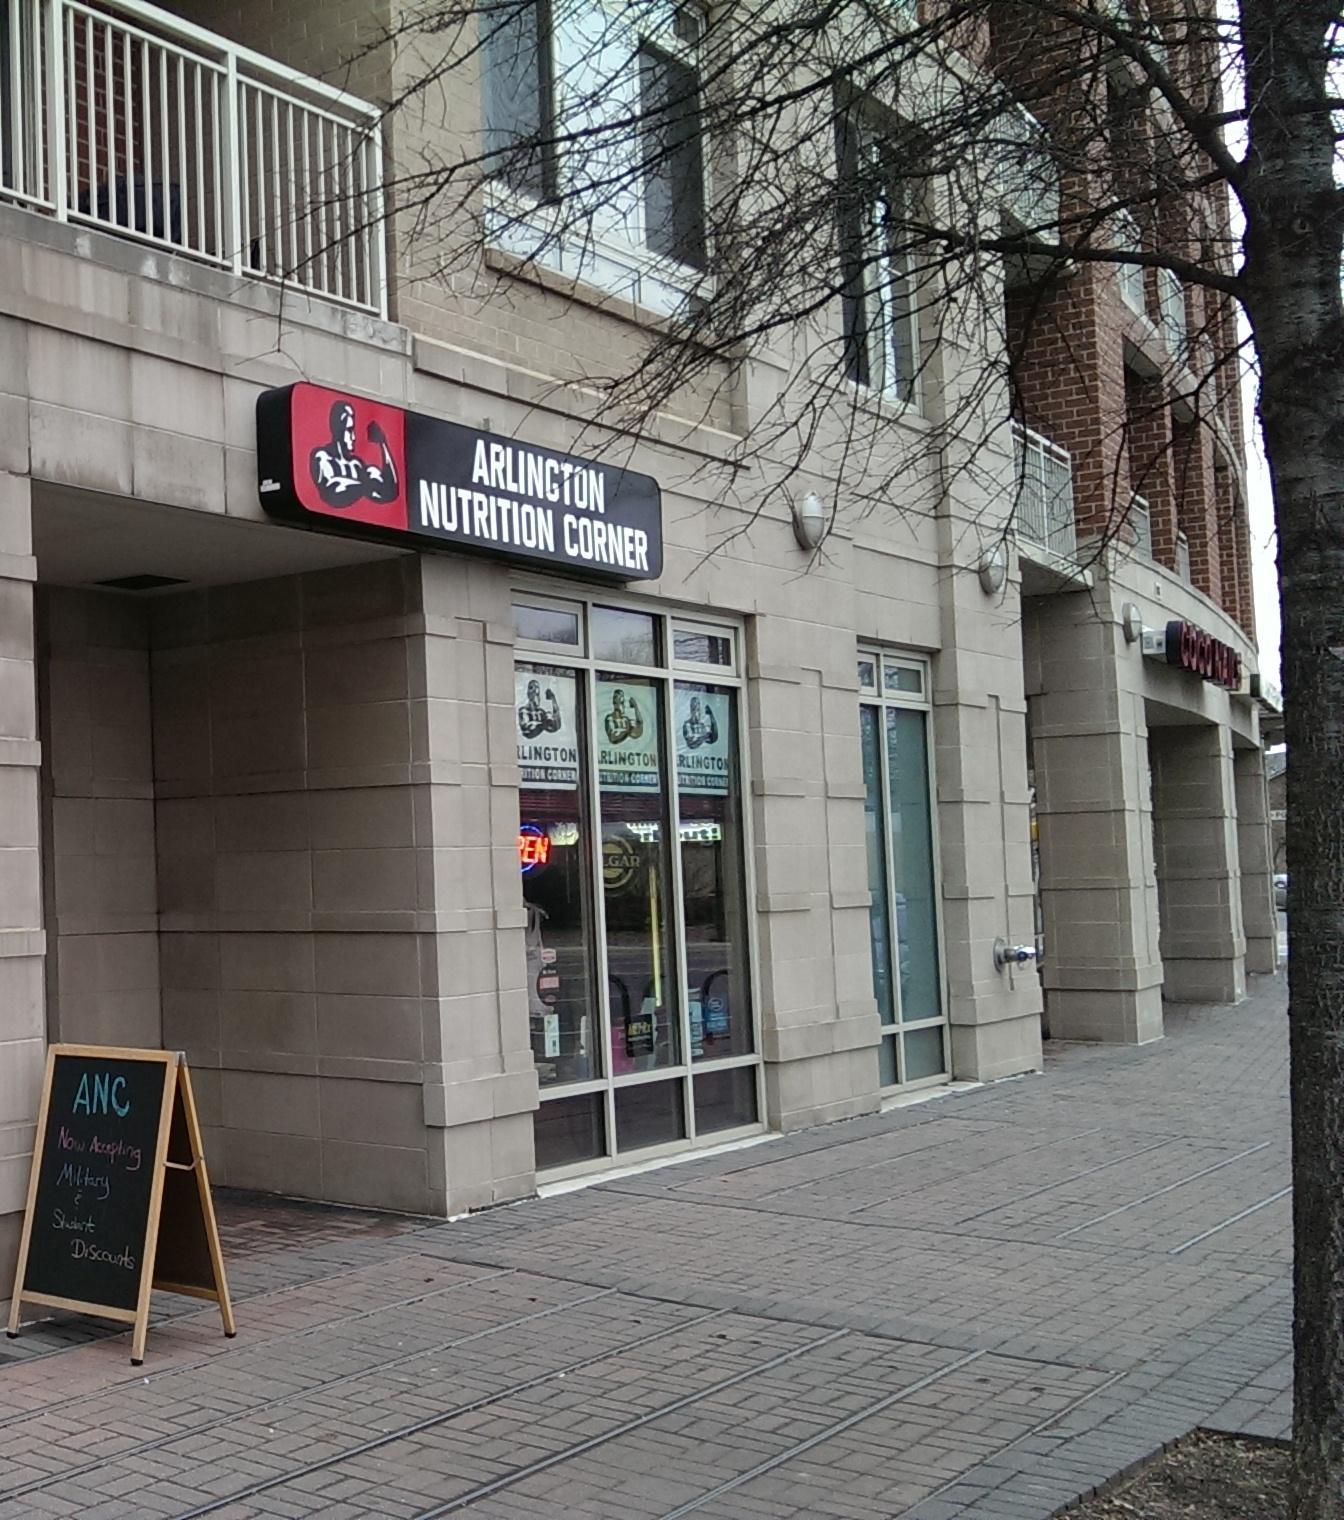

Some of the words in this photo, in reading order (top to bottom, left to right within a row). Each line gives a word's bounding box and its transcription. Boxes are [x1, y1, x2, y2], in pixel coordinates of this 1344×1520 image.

[472, 438, 605, 514] ARLINGTON
[419, 479, 555, 553] NUTRITION
[563, 514, 649, 572] CORNER
[517, 745, 577, 763] LINGTON
[678, 754, 729, 770] RLINGTON
[518, 835, 549, 863] PEN
[72, 1072, 131, 1117] ANC
[58, 1126, 86, 1150] Now
[89, 1135, 142, 1171] Accepting
[56, 1162, 110, 1200] Military
[70, 1238, 136, 1270] Discounts
